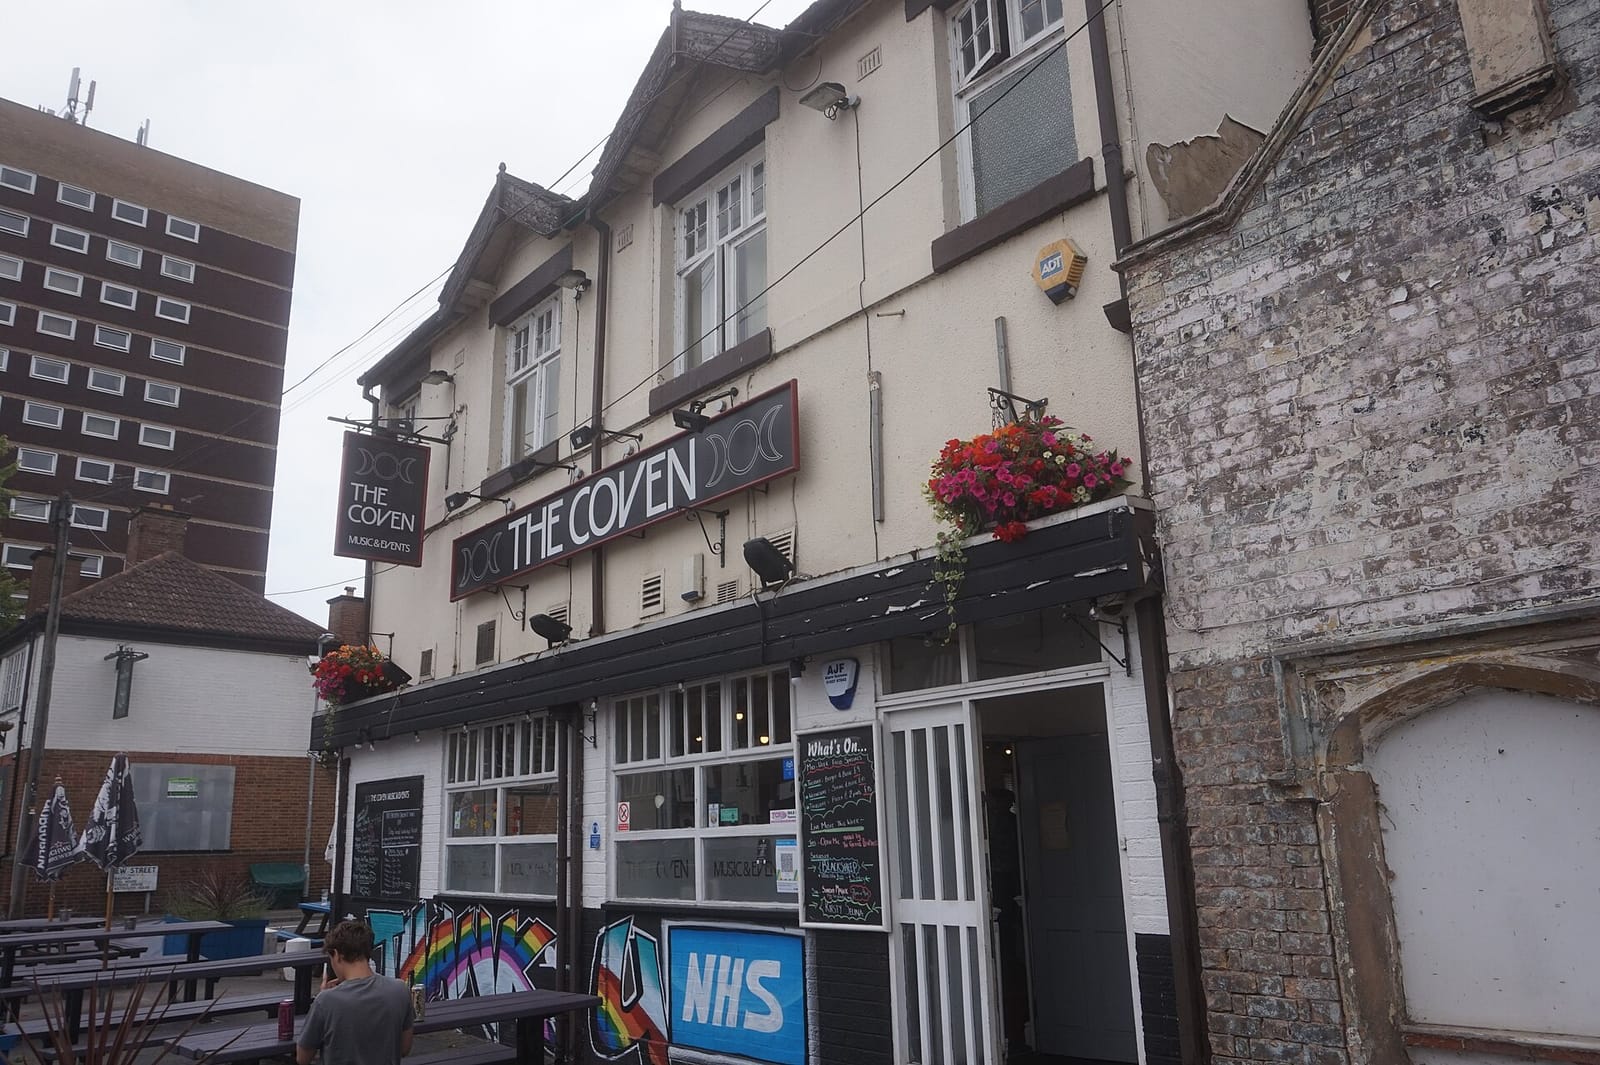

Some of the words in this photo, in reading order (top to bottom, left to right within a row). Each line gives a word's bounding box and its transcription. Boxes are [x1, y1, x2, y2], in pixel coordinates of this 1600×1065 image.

[1041, 255, 1062, 275] ADT
[350, 482, 388, 506] THE
[508, 498, 564, 571] THE
[568, 437, 697, 546] COVEN
[348, 504, 415, 532] COVEN
[827, 663, 845, 675] AJF
[807, 739, 841, 757] What's
[843, 737, 867, 754] On...
[682, 952, 784, 1034] NHS
